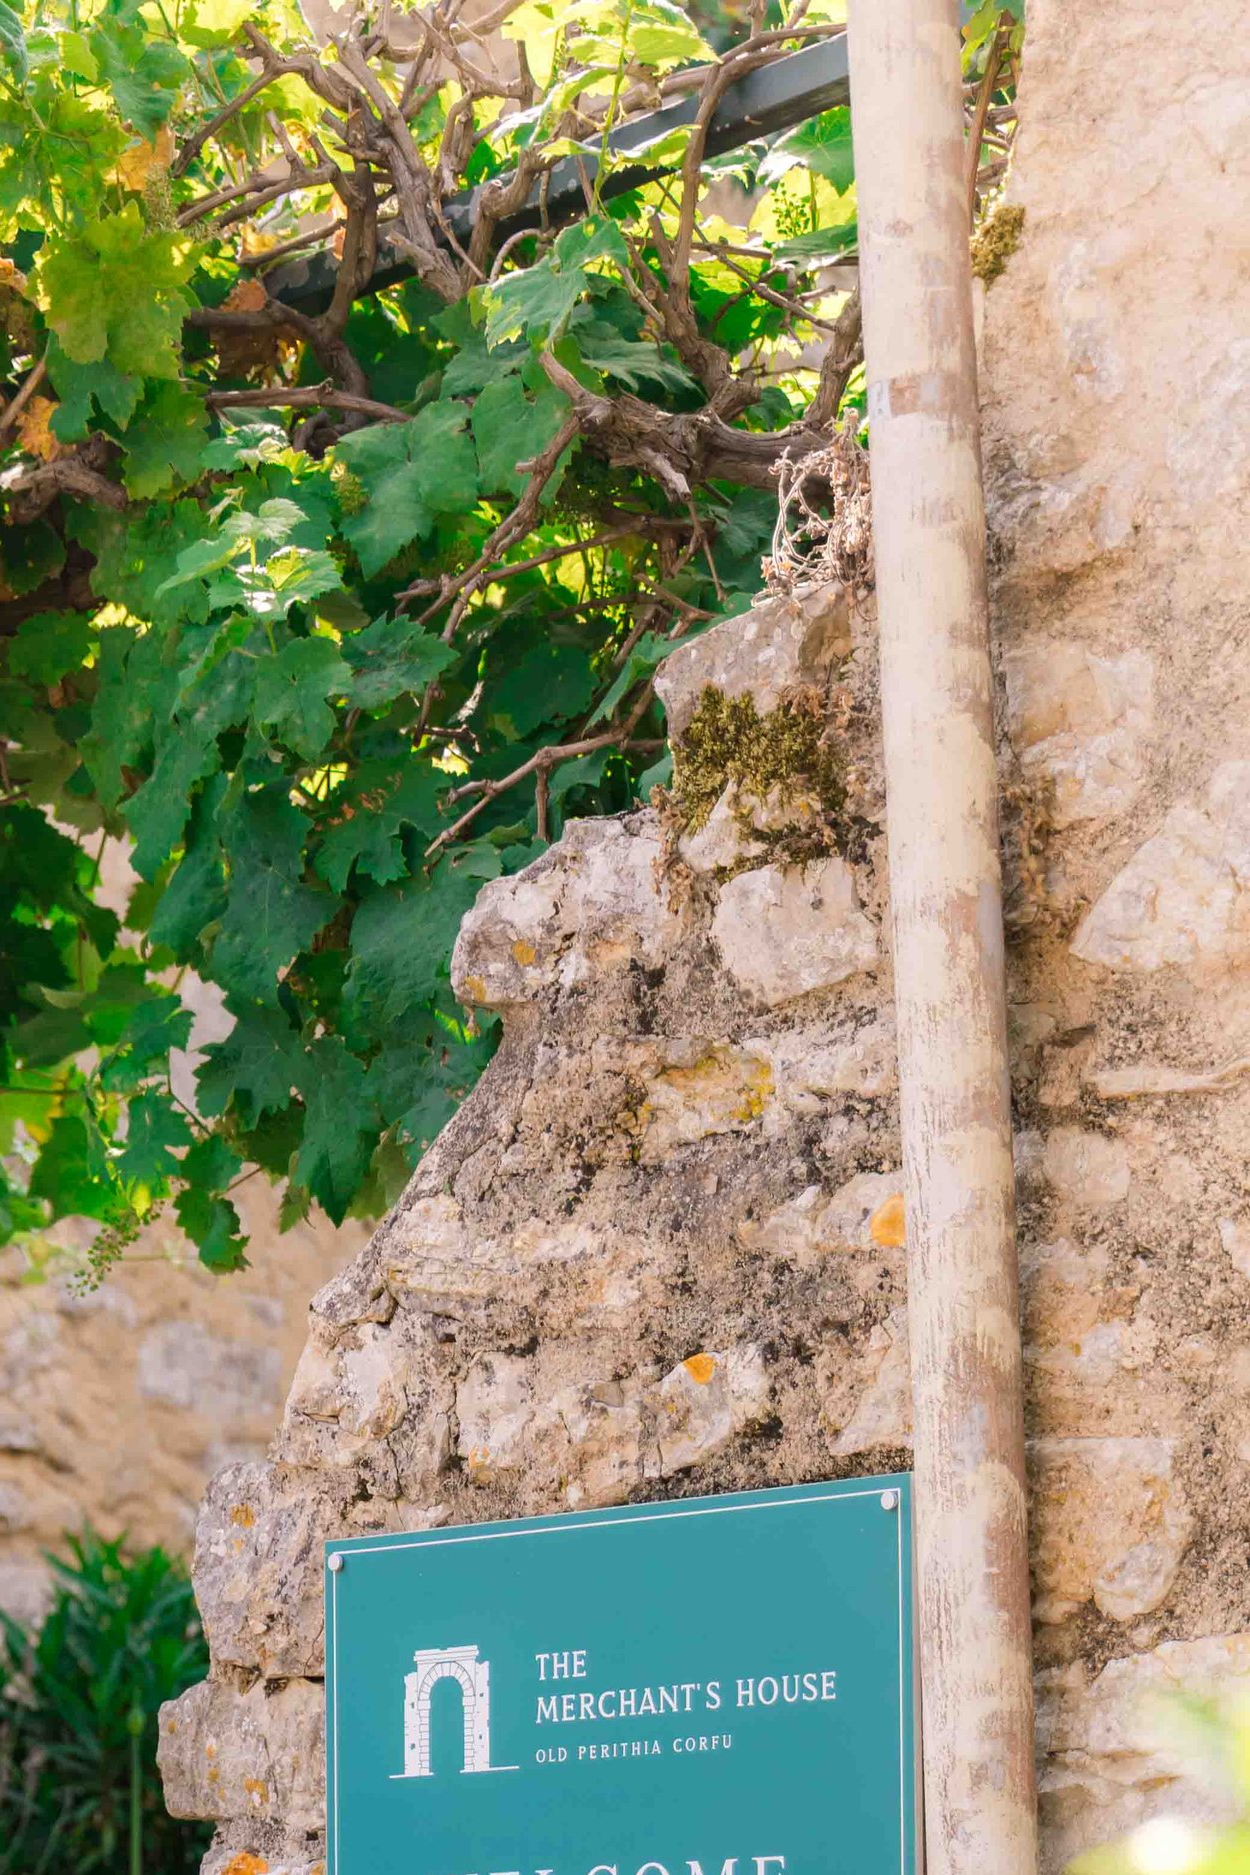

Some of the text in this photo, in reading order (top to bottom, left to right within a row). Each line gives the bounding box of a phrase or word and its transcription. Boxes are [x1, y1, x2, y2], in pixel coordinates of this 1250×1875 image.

[535, 1650, 588, 1681] THE
[535, 1671, 837, 1724] MERCHANT'S HOUSE
[535, 1734, 733, 1763] OLD PERITHIA CORFU
